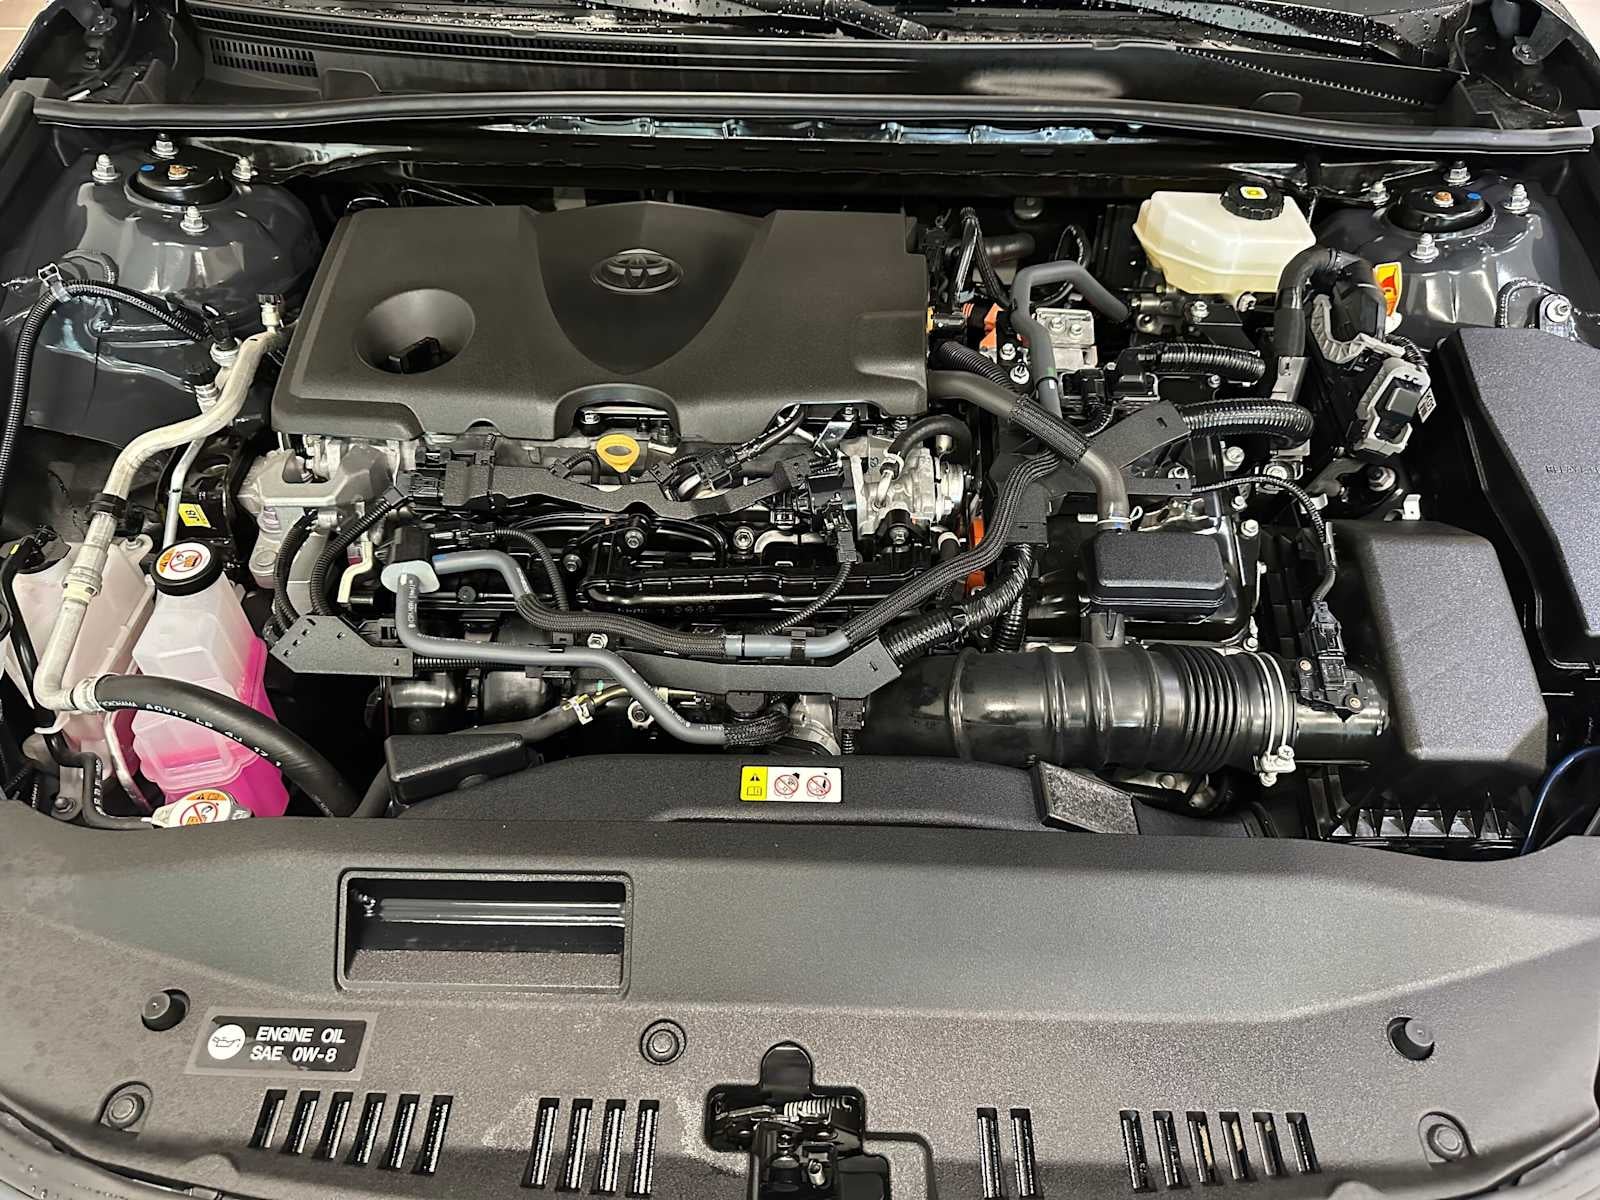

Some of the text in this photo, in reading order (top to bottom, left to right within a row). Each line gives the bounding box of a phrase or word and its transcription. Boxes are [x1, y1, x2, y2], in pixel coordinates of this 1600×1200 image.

[255, 1026, 346, 1044] ENGINE OIL
[250, 1045, 337, 1063] SAE 0W-8
